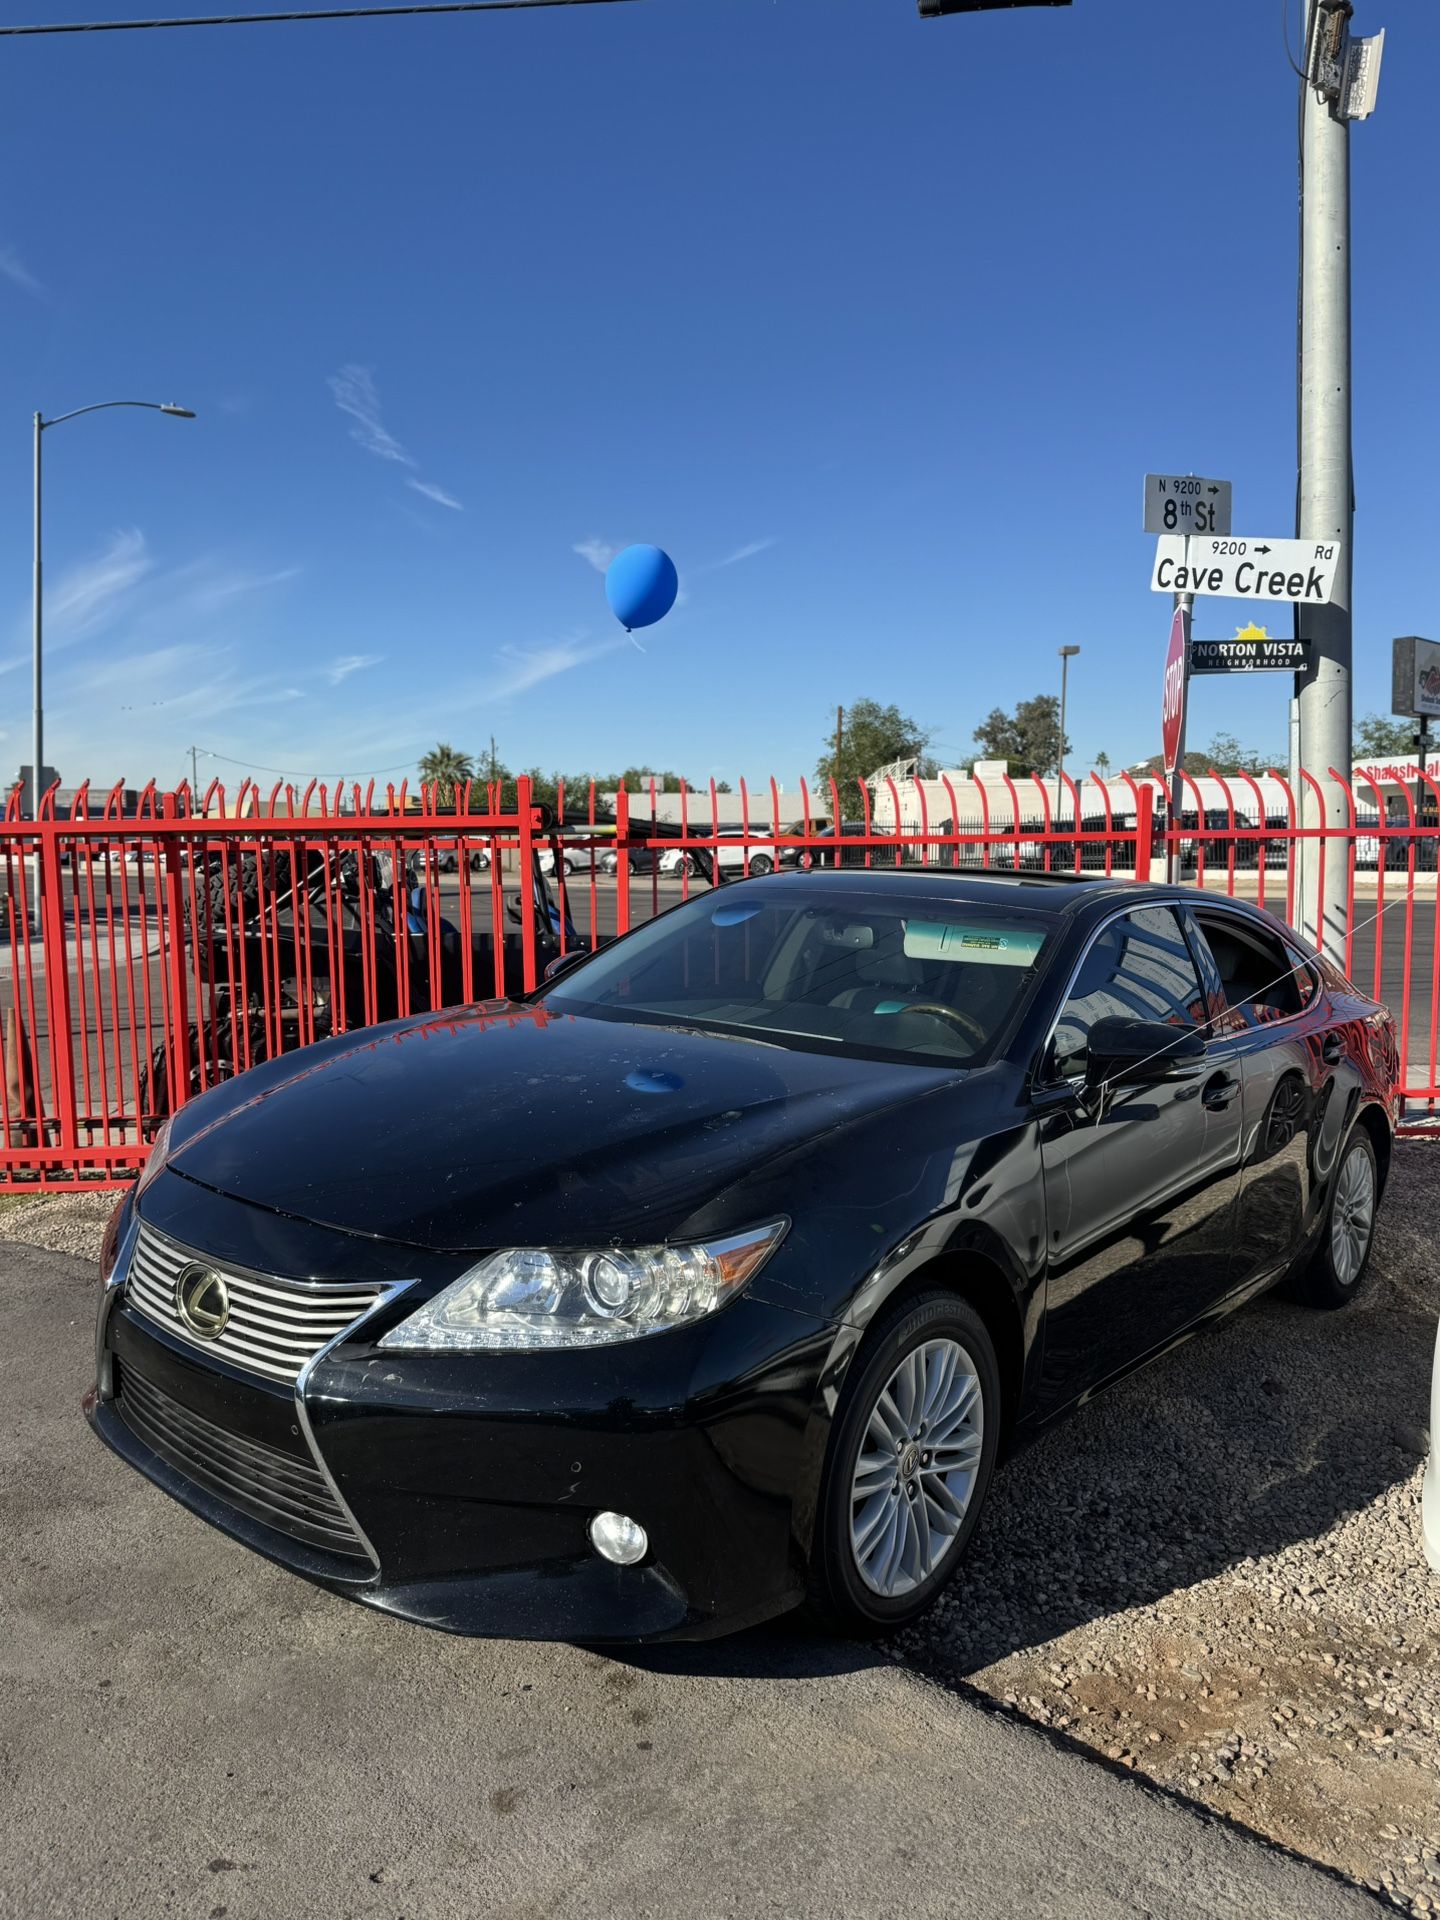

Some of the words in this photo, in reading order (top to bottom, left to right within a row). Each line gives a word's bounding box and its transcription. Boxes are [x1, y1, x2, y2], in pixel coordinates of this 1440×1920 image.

[1158, 479, 1166, 493] N
[1173, 480, 1202, 495] 9200
[1194, 500, 1216, 532] St
[1211, 541, 1247, 556] 9200
[1314, 545, 1334, 560] Rd
[1157, 558, 1223, 591] Cave
[1234, 562, 1325, 598] Creek
[1197, 643, 1256, 657] NORTON
[1263, 643, 1304, 656] VISTA
[1208, 658, 1291, 667] NEIGHBORHOOD
[1163, 655, 1183, 723] STOP
